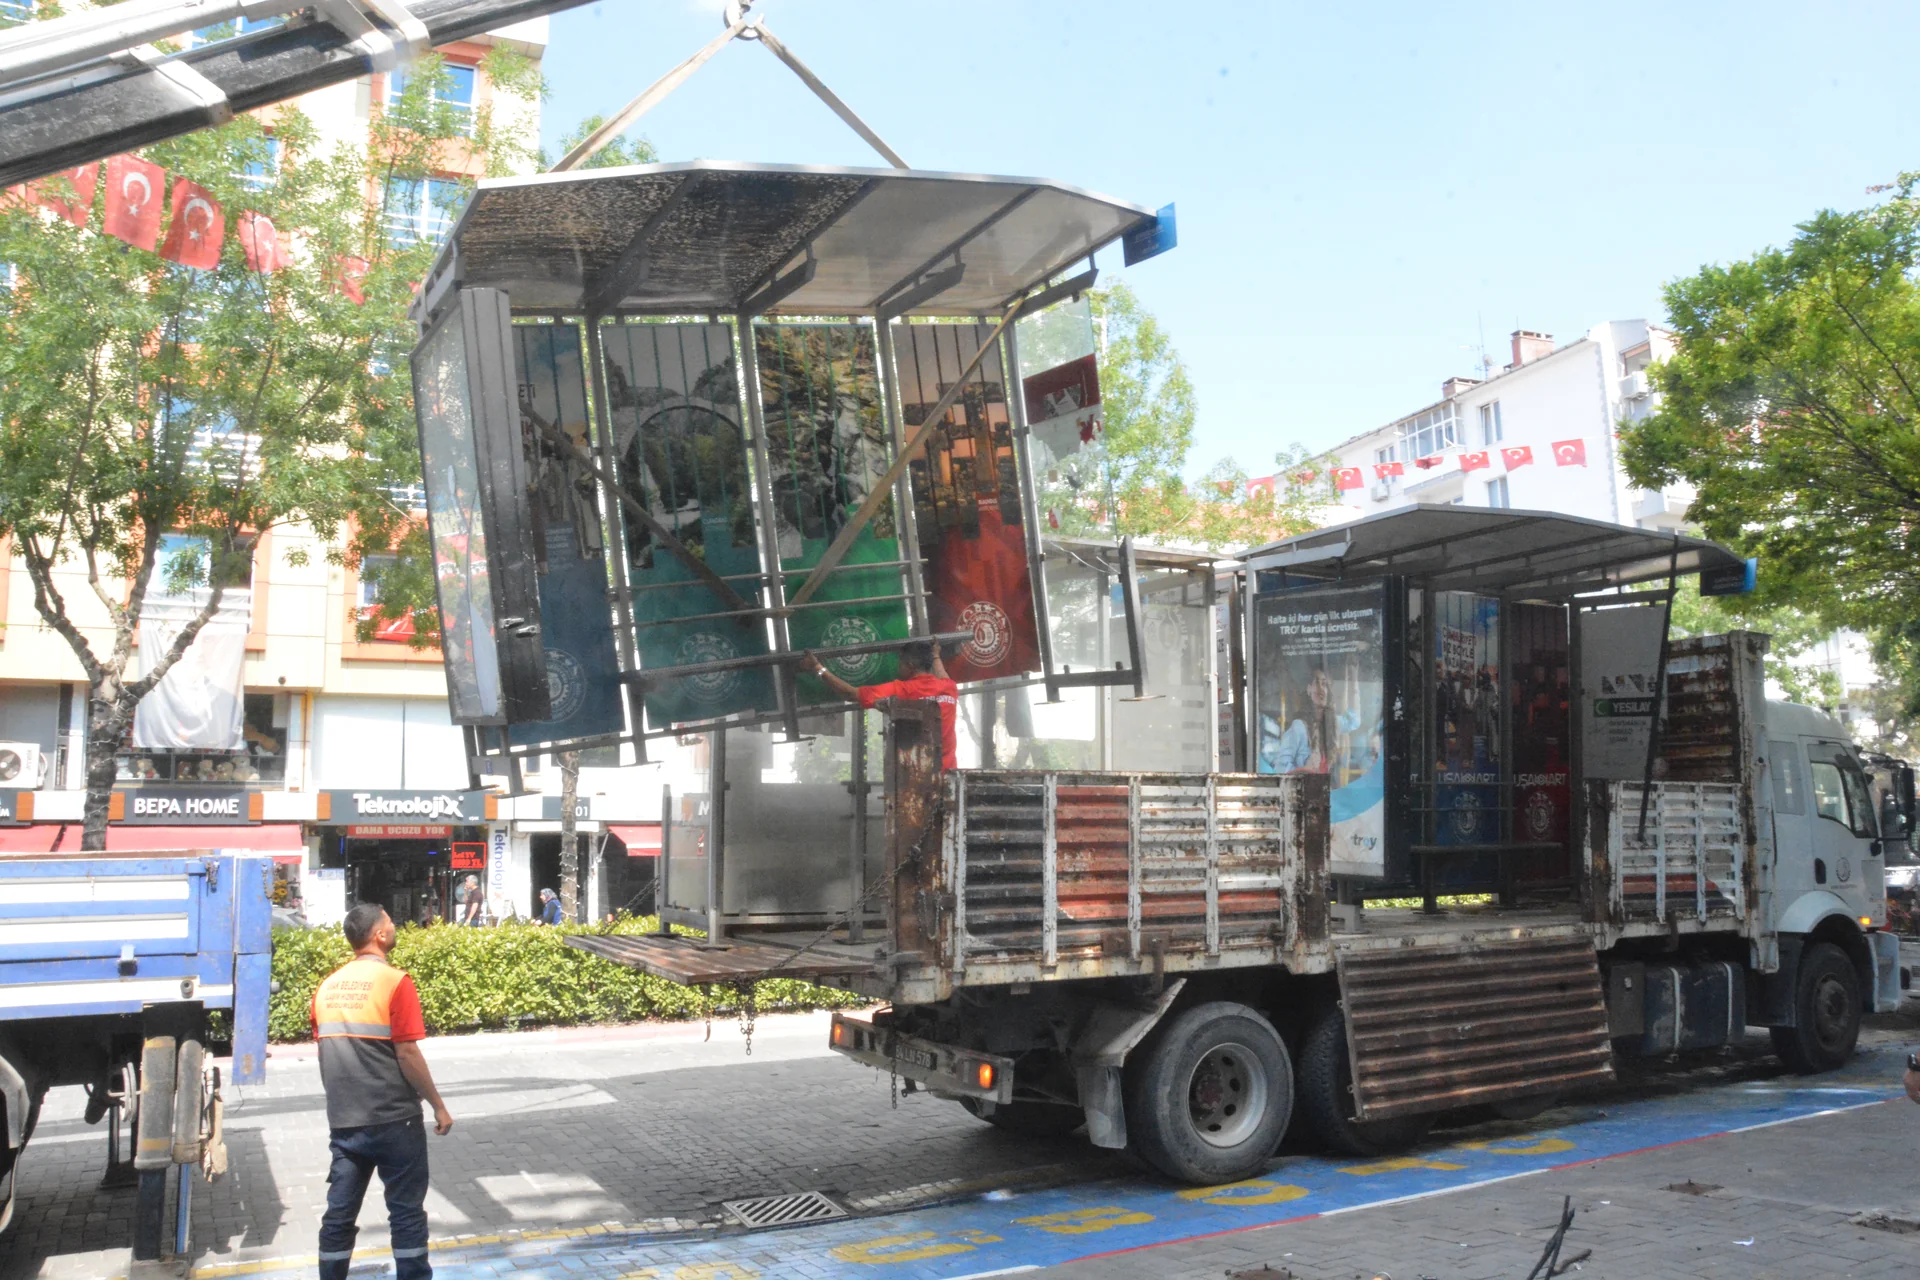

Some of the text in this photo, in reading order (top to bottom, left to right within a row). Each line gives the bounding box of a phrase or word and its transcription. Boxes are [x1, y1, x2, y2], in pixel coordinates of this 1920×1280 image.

[1298, 611, 1312, 622] her
[1301, 623, 1326, 634] kartla
[134, 798, 240, 814] BEPA HOME
[355, 826, 445, 835] DAHA UCUZU YOK
[916, 1050, 932, 1068] 578
